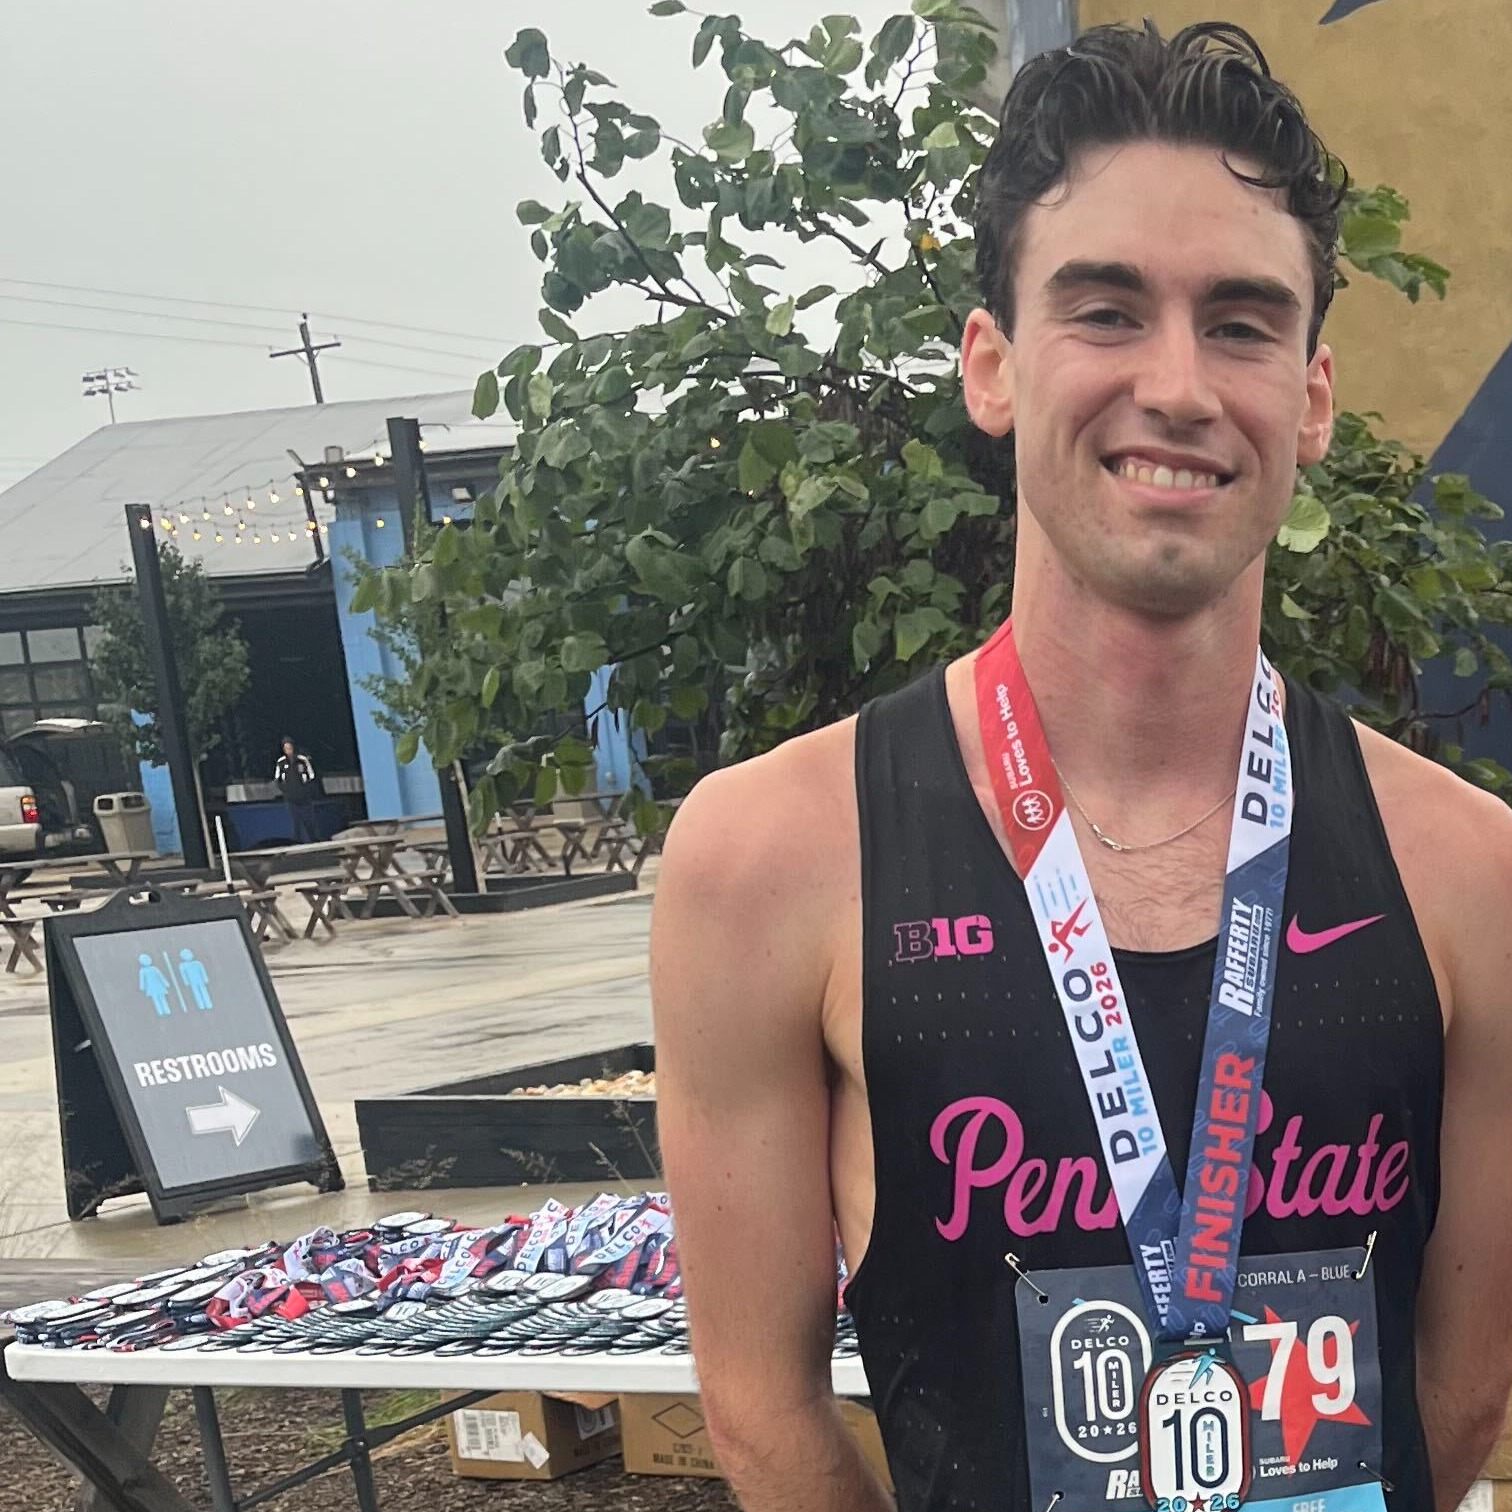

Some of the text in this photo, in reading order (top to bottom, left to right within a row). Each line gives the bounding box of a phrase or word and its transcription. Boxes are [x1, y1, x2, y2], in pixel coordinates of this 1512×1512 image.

[996, 683, 1033, 787] Loves to Help
[1269, 802, 1286, 829] 10
[1219, 896, 1255, 1017] RAFFERTY
[133, 1043, 278, 1088] RESTROOMS
[1062, 968, 1140, 1165] DELCO
[1090, 961, 1158, 1157] 10 MILER 2026
[929, 1087, 1410, 1242] Pen tate
[1184, 1053, 1256, 1303] FINISHER
[517, 1229, 543, 1272] DELCO
[595, 1224, 641, 1259] DELCO
[1237, 1270, 1294, 1288] CORRAL
[1296, 1269, 1307, 1283] A
[1321, 1264, 1350, 1281] BLUE
[1070, 1336, 1130, 1350] DELCO
[1227, 1315, 1356, 1422] 79
[1073, 1348, 1134, 1422] 10
[1107, 1361, 1121, 1408] MILER
[1156, 1390, 1233, 1406] DELCO
[1162, 1406, 1229, 1491] 10
[1202, 1420, 1215, 1477] MILER
[1259, 1456, 1291, 1466] SUBARU
[1260, 1457, 1338, 1478] Loves to Help
